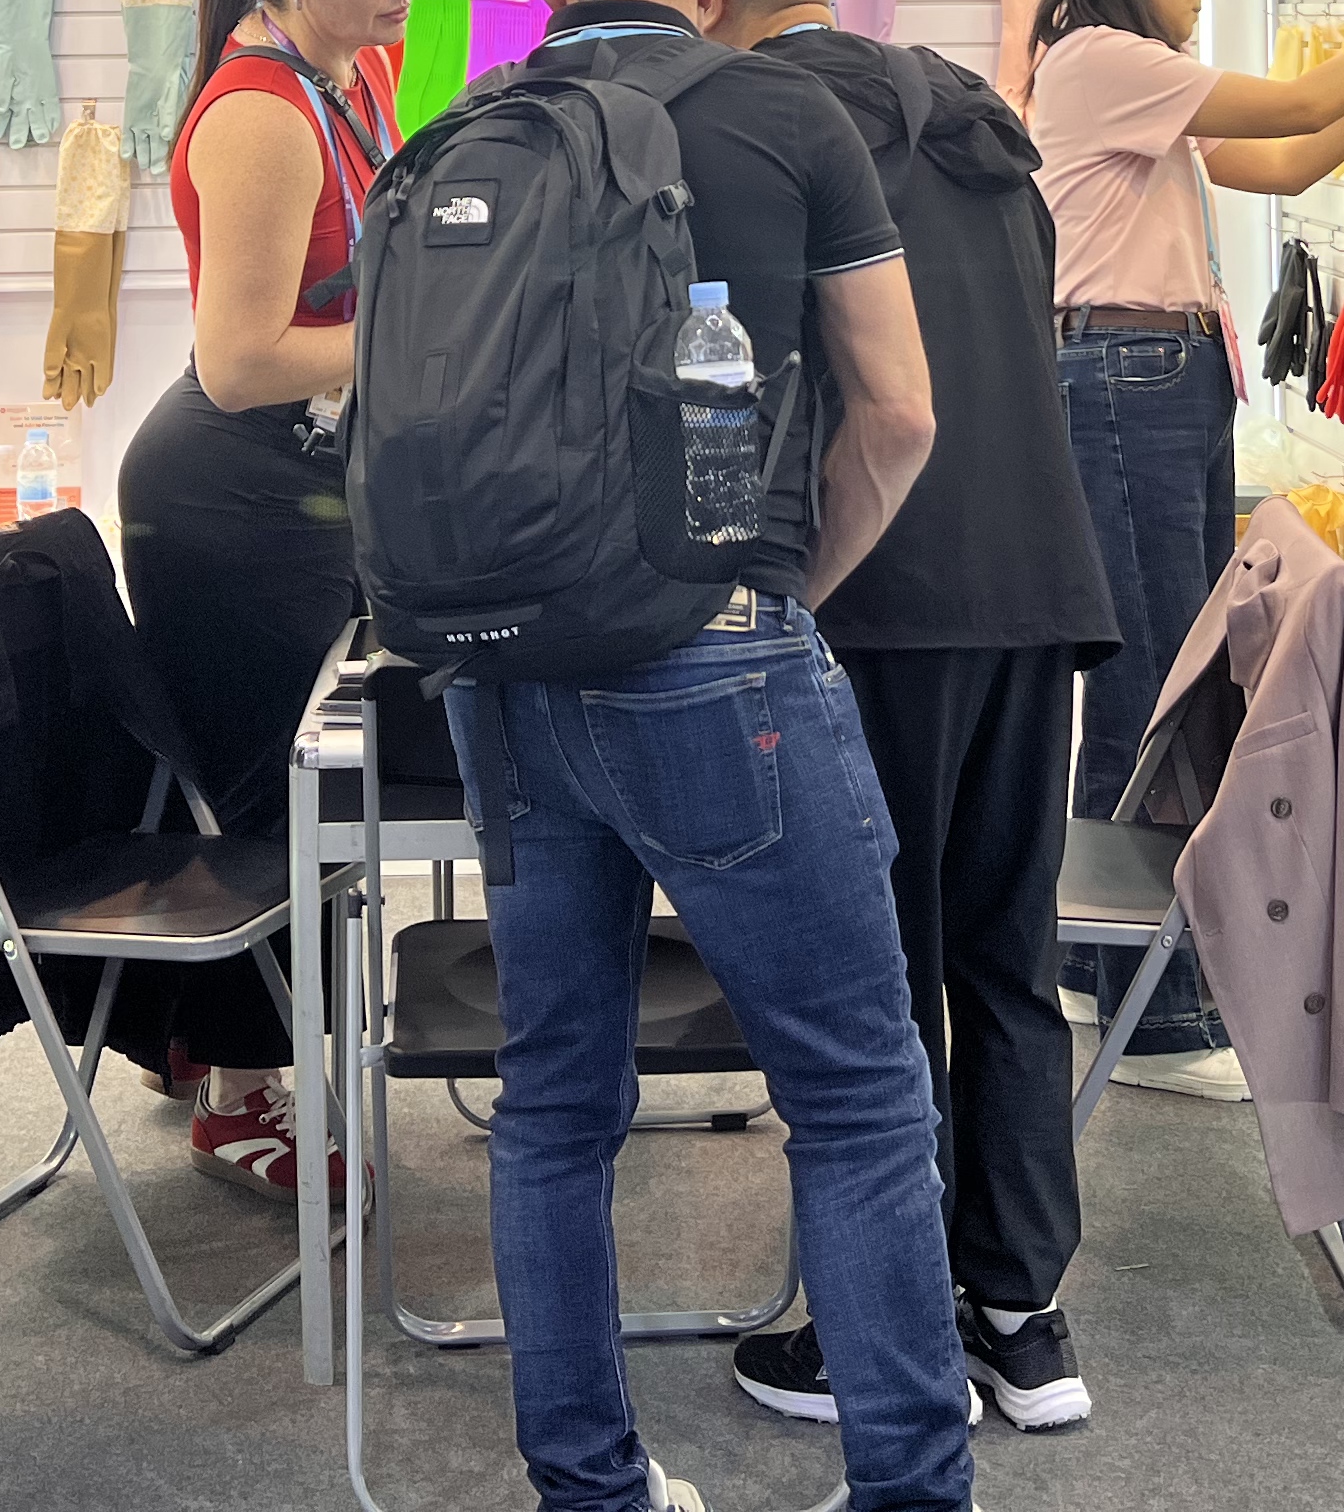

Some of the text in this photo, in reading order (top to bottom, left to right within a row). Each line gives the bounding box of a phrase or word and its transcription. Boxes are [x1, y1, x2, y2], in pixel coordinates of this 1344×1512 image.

[450, 197, 472, 207] THE
[432, 206, 471, 217] NORTH
[441, 215, 469, 225] FACE
[446, 632, 473, 643] HOT
